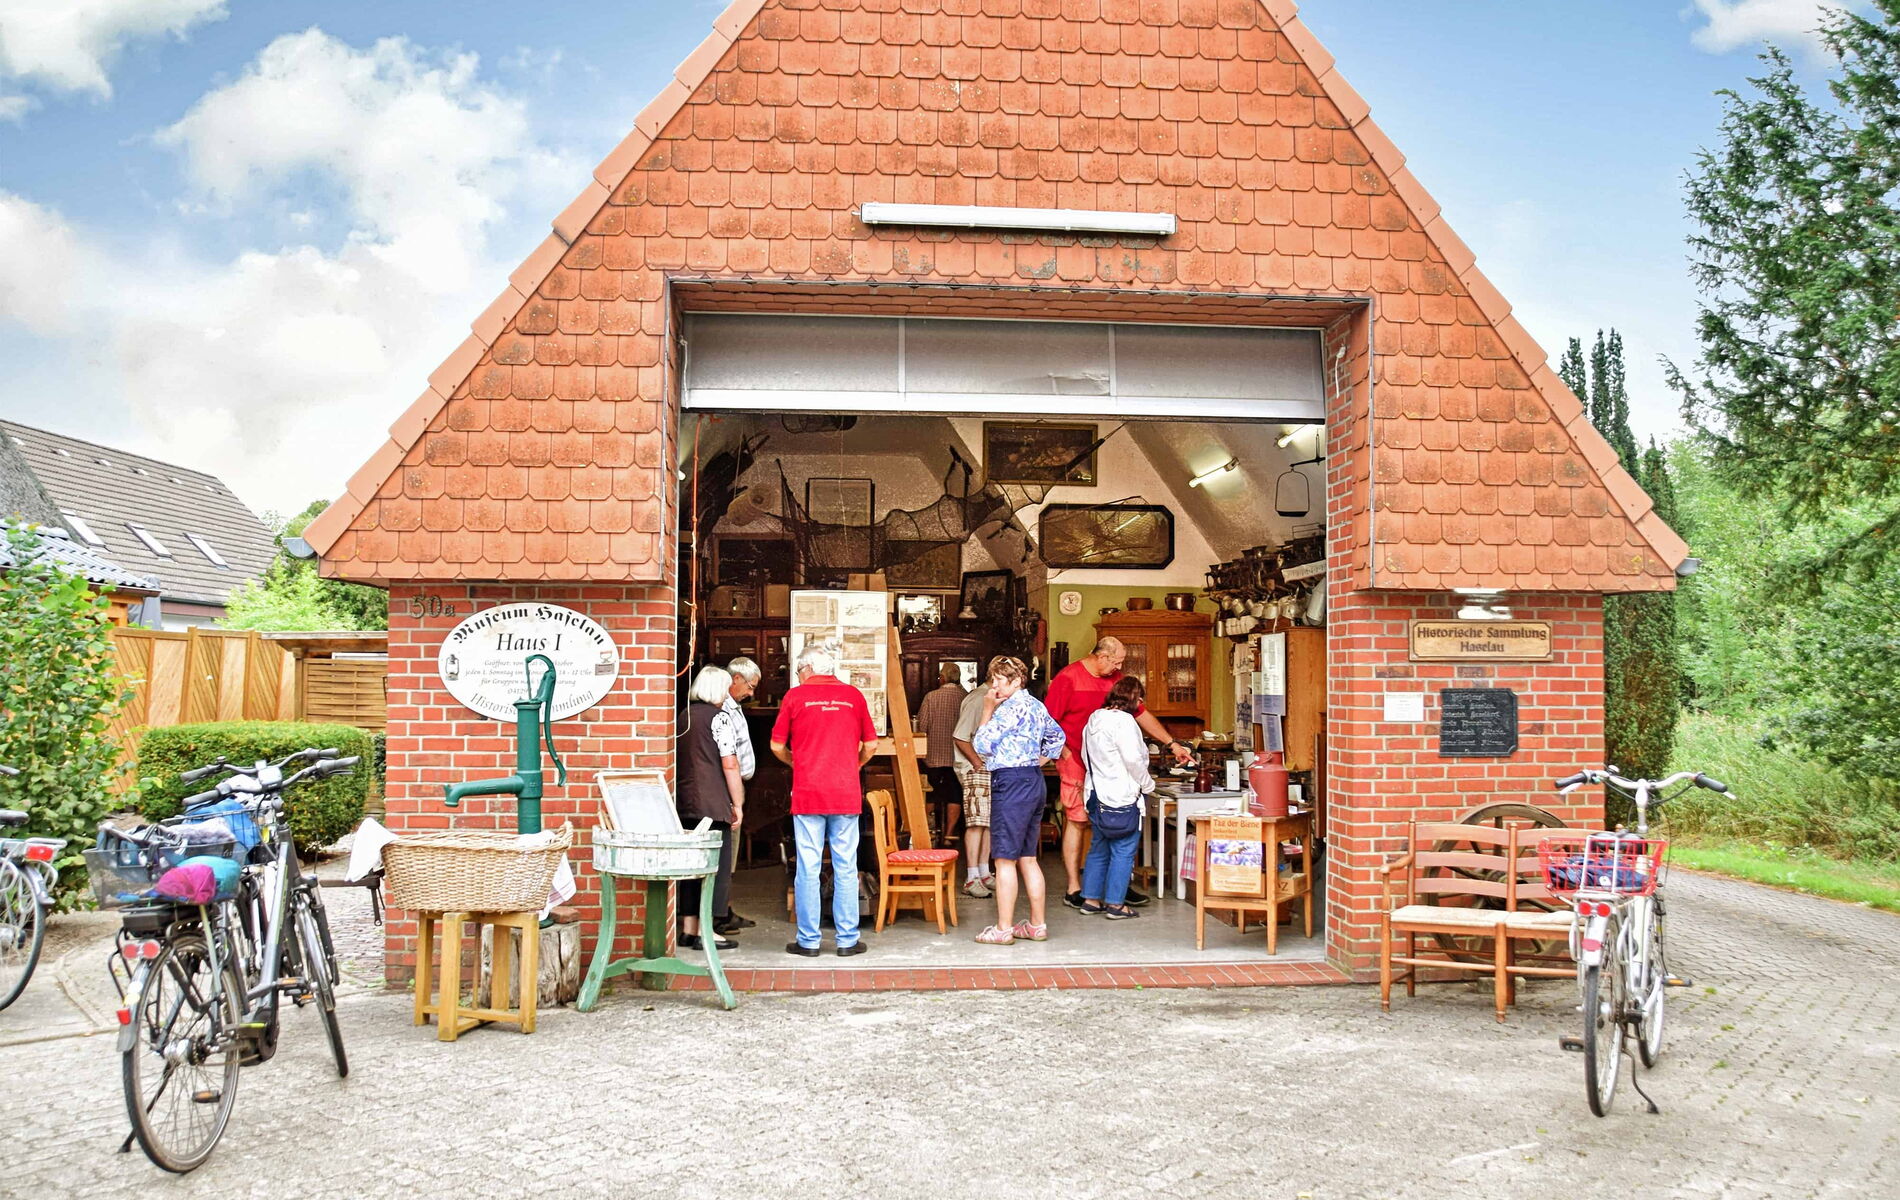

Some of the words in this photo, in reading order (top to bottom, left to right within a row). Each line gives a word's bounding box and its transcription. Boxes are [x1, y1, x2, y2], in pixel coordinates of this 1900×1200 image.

[410, 594, 456, 619] 50a
[453, 608, 529, 644] Museum
[535, 606, 605, 645] Haselau
[1417, 626, 1483, 638] Historische
[1487, 626, 1547, 640] Sammlung
[496, 632, 547, 651] Haus
[553, 633, 562, 651] I
[1460, 641, 1505, 653] Haselau
